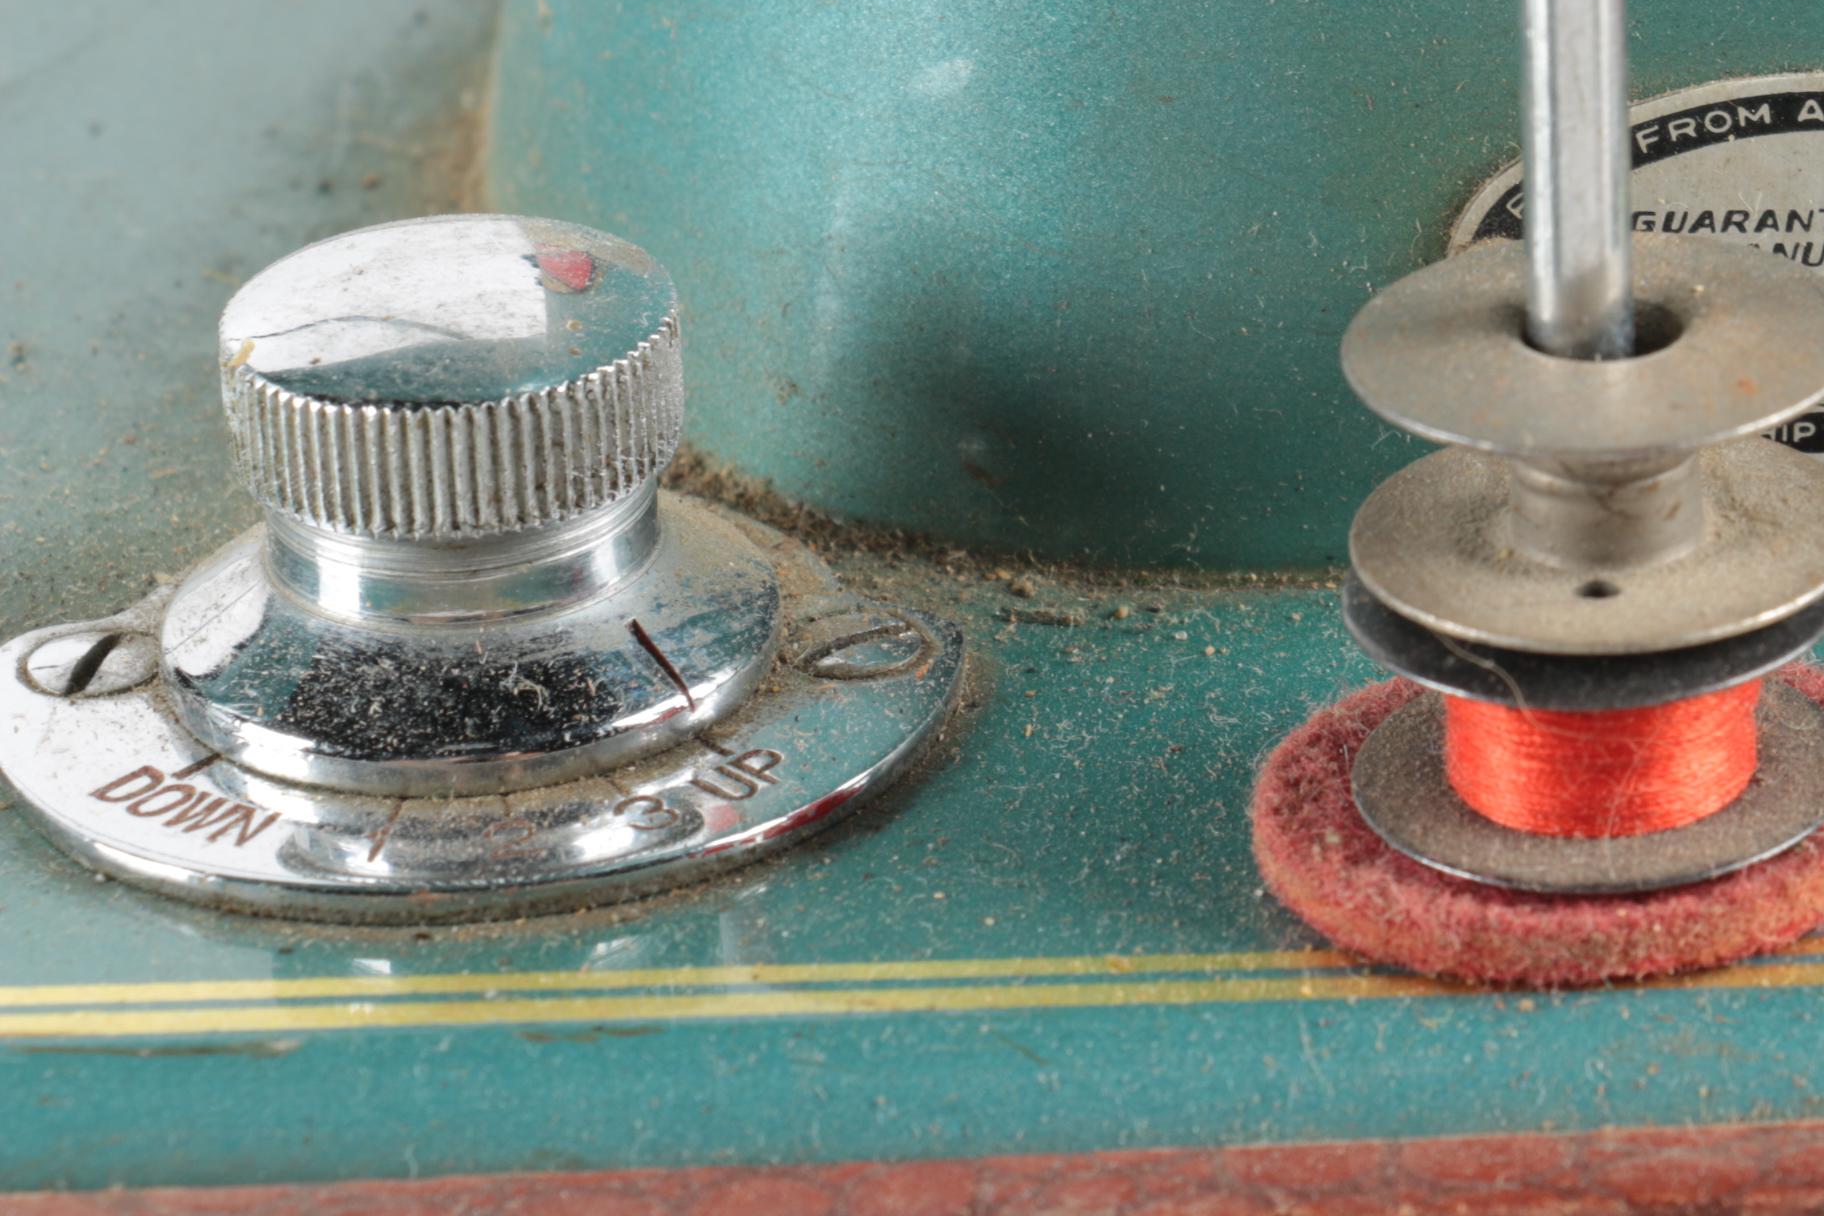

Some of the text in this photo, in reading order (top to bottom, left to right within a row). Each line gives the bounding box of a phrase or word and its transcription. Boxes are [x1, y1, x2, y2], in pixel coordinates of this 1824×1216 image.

[1635, 103, 1772, 154] FROM
[91, 765, 281, 846] DOWN
[613, 795, 680, 830] 3
[689, 748, 784, 801] UP
